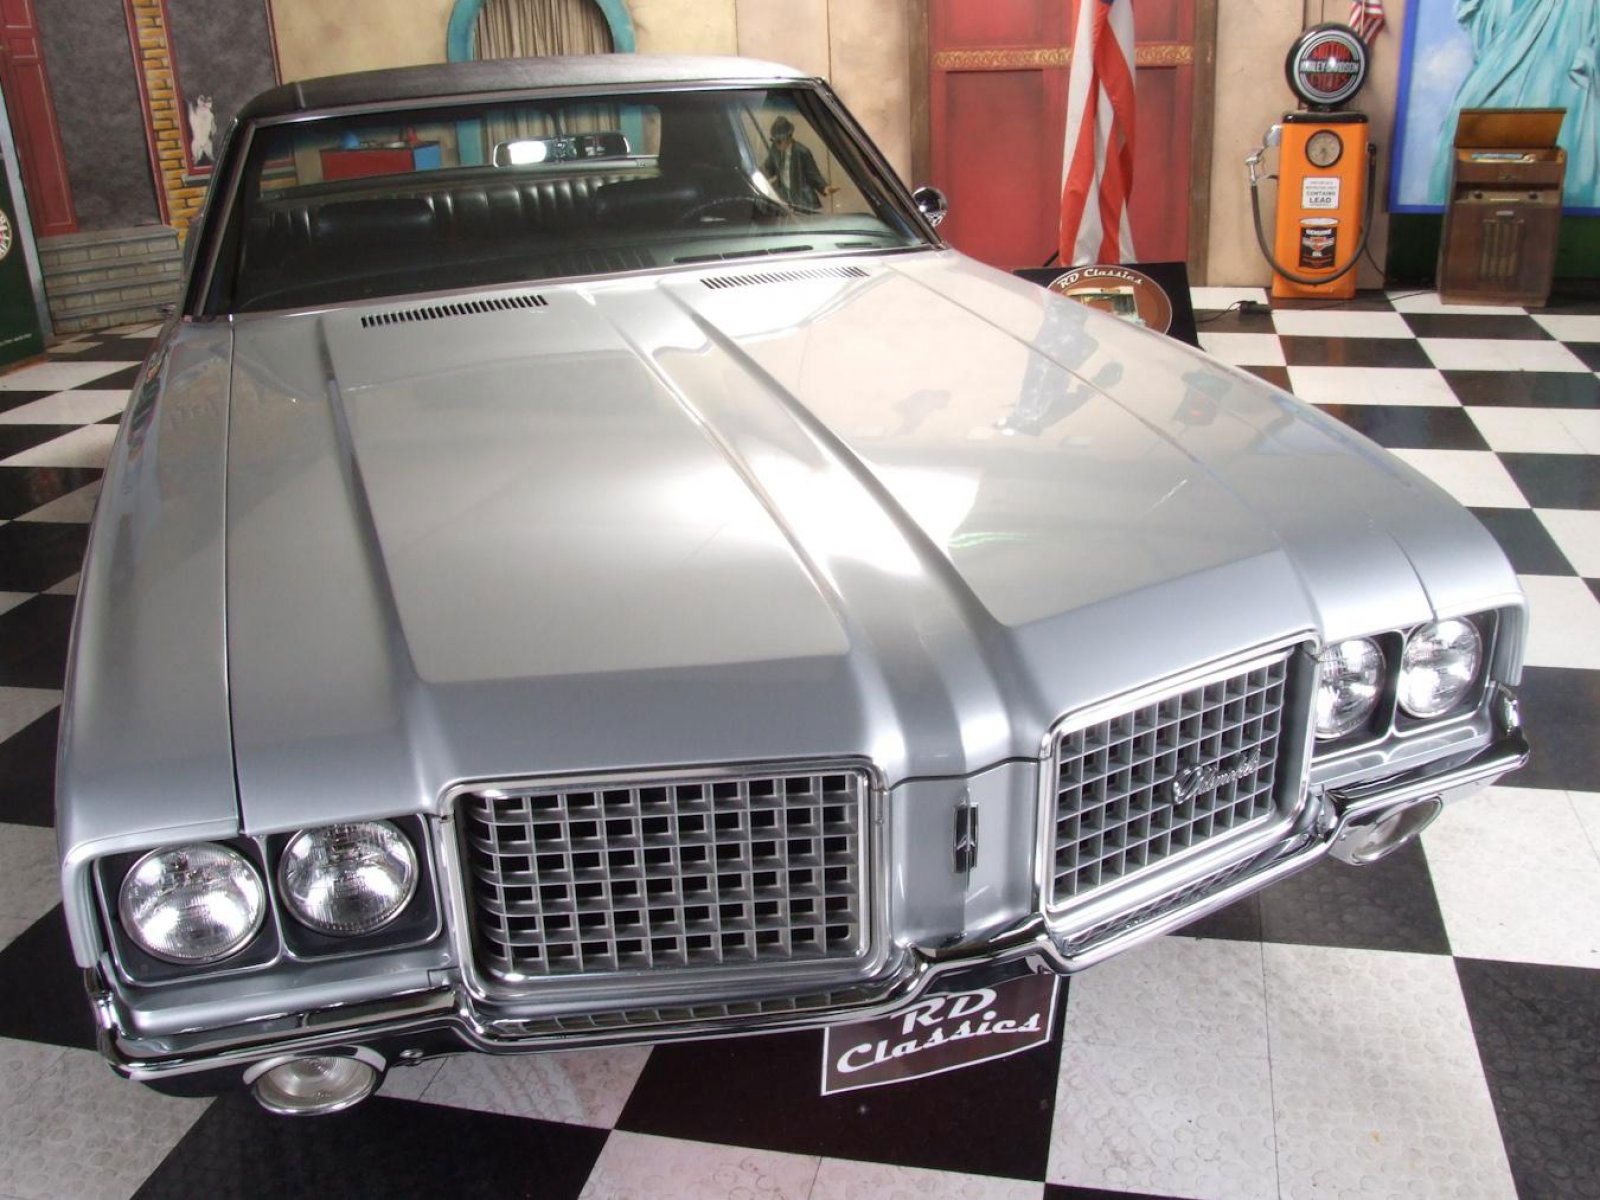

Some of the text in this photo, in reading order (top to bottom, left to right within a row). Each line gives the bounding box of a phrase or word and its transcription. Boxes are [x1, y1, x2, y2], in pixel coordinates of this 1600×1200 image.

[1056, 268, 1143, 289] RD Classics
[890, 987, 998, 1035] RD
[836, 1010, 1041, 1074] Classics
